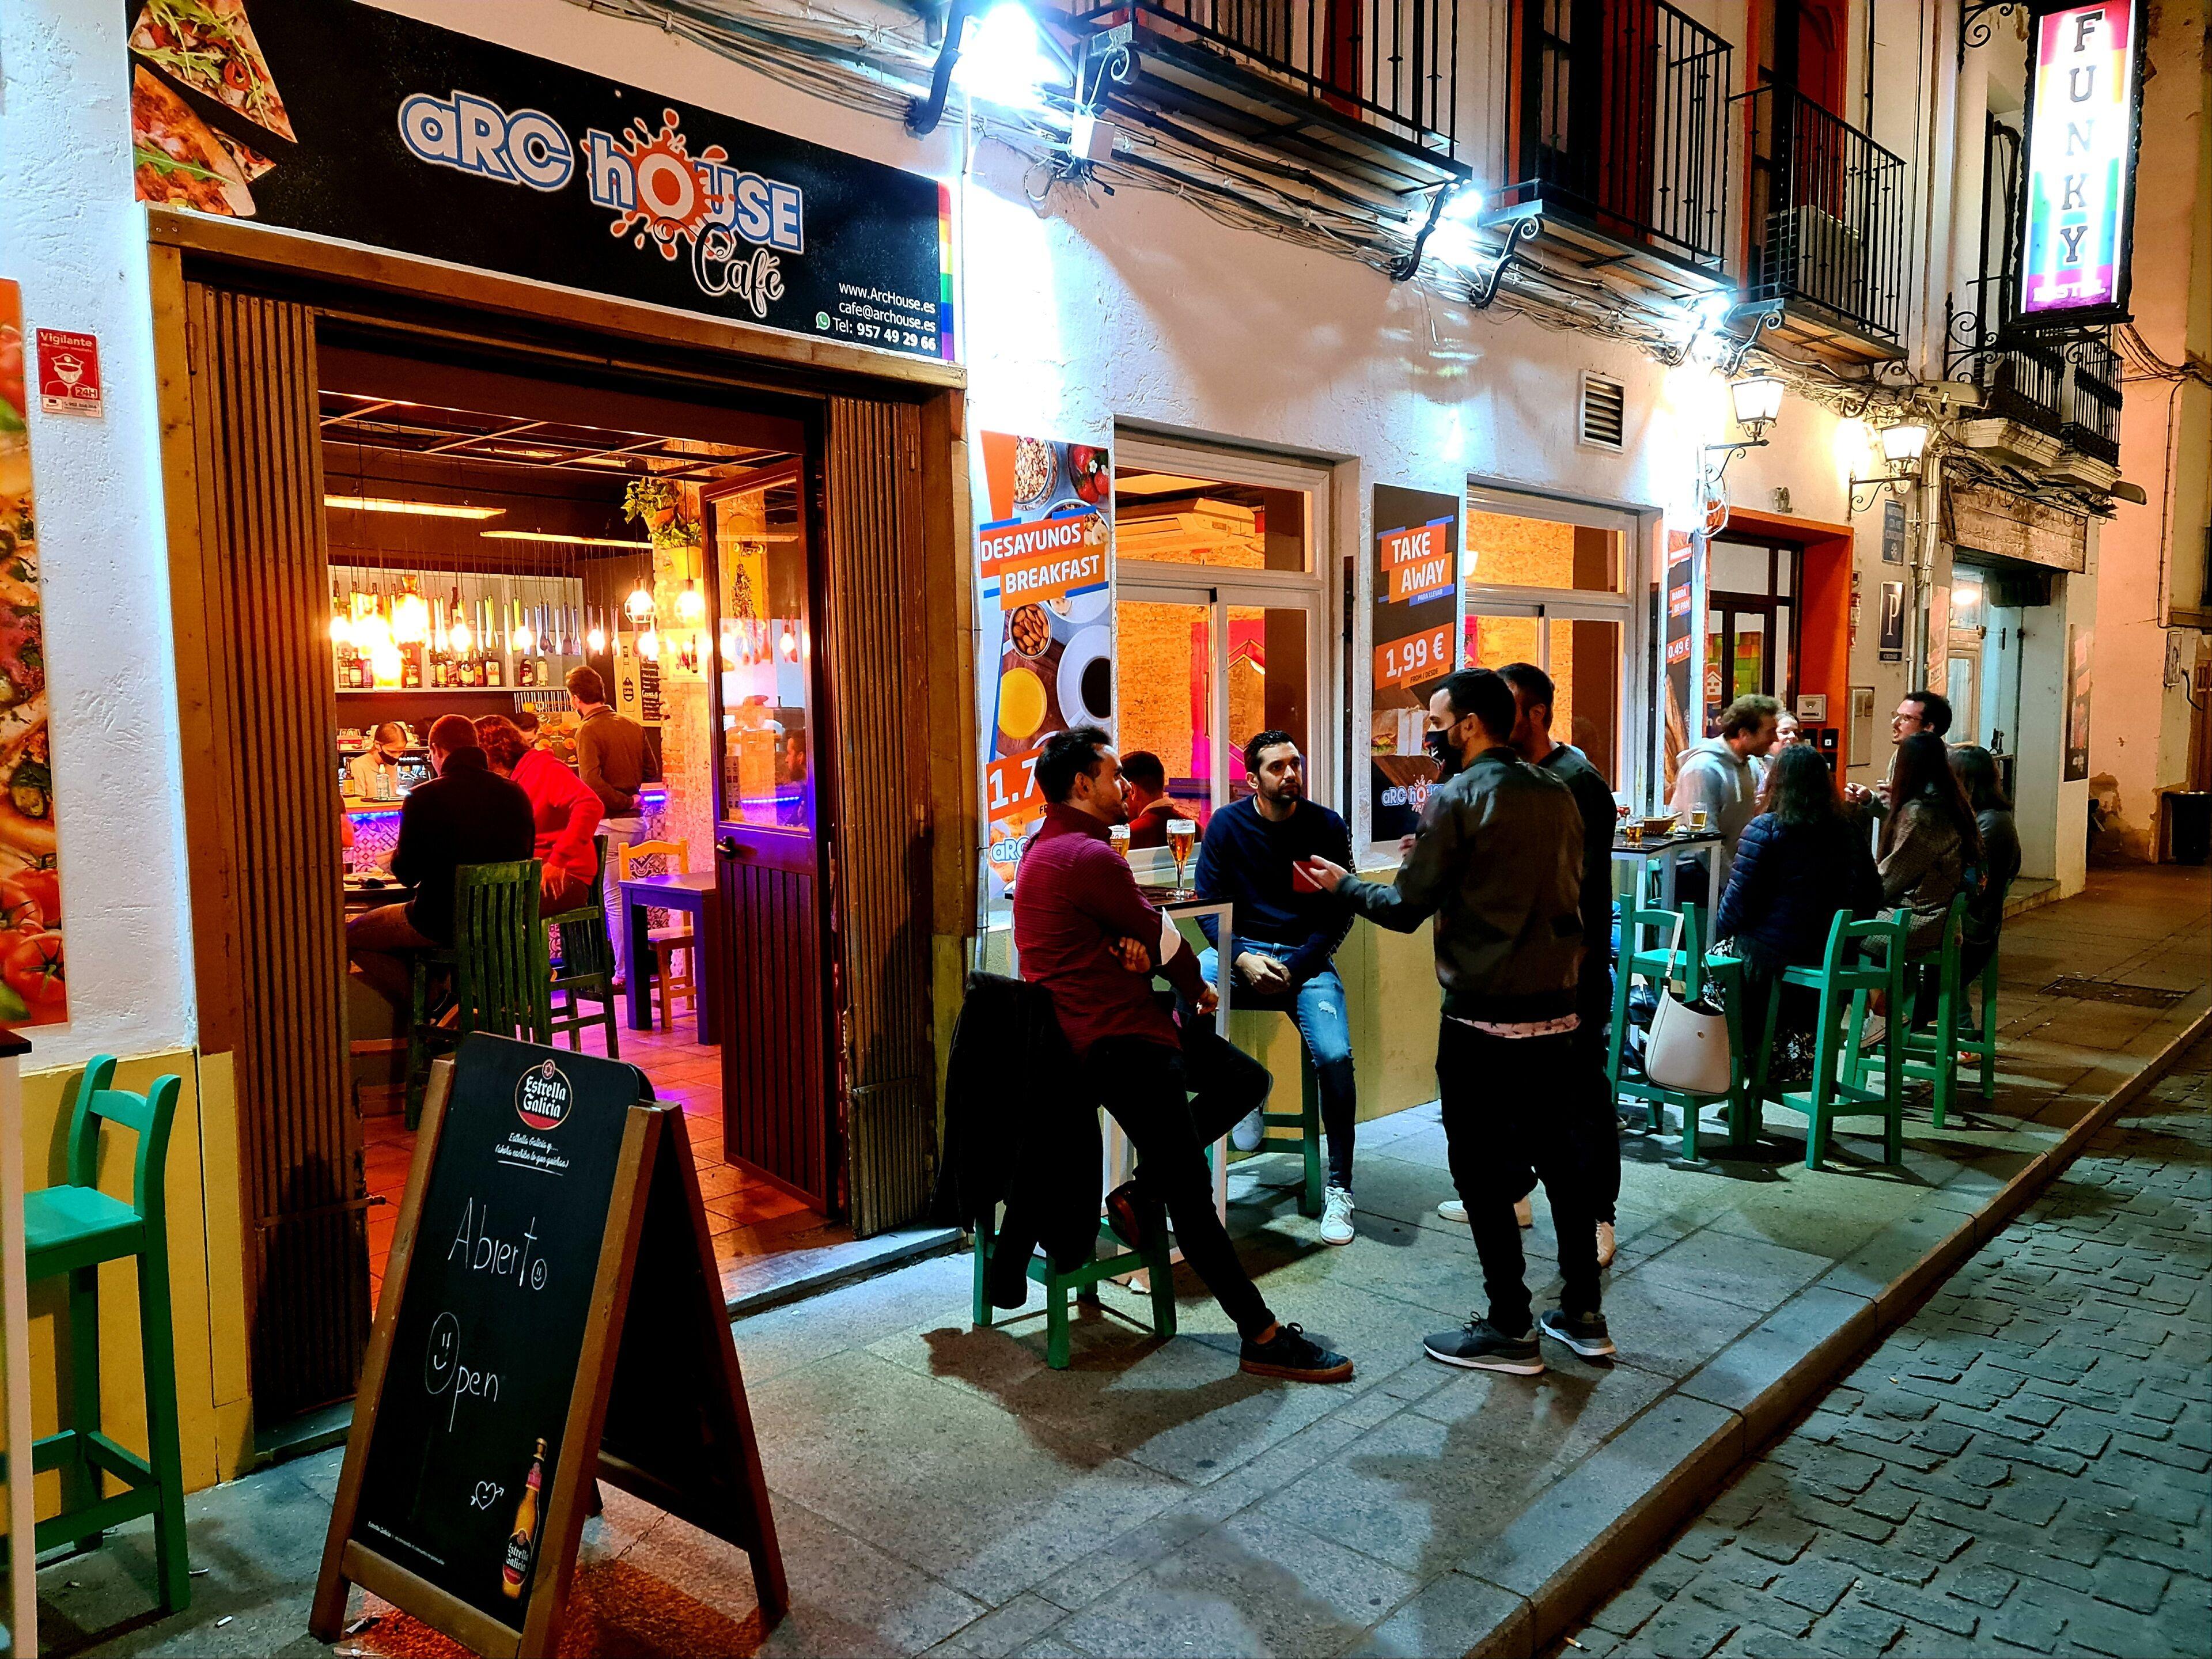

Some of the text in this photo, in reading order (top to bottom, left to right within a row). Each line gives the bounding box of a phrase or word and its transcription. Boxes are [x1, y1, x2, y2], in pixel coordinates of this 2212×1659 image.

[2060, 10, 2104, 263] FUNKY
[653, 216, 784, 317] Café
[838, 282, 936, 314] www.ArcHouse.es
[839, 301, 936, 332] cafe@archouse.es
[40, 331, 93, 347] Vigilante
[832, 317, 937, 351] Tel: 957 49 29 66
[75, 388, 97, 399] 24H
[980, 522, 1081, 562] DESAYUNOS
[1391, 531, 1431, 564] TAKE
[1005, 554, 1100, 594] BREAKFAST
[1401, 558, 1445, 593] AWAY
[1888, 593, 1900, 636] P
[1386, 632, 1444, 678] 1,99 €
[1668, 641, 1684, 658] 0.49
[1685, 638, 1690, 651] €
[1410, 674, 1422, 683] FROM
[1425, 668, 1439, 678] DESDE
[989, 756, 1039, 810] 1.7
[524, 1075, 566, 1101] Estrella
[523, 1093, 561, 1118] Galicia
[448, 1197, 547, 1290] Abierto
[426, 1312, 498, 1433] Open
[506, 1554, 526, 1571] Galicia
[508, 1543, 529, 1562] Estrella
